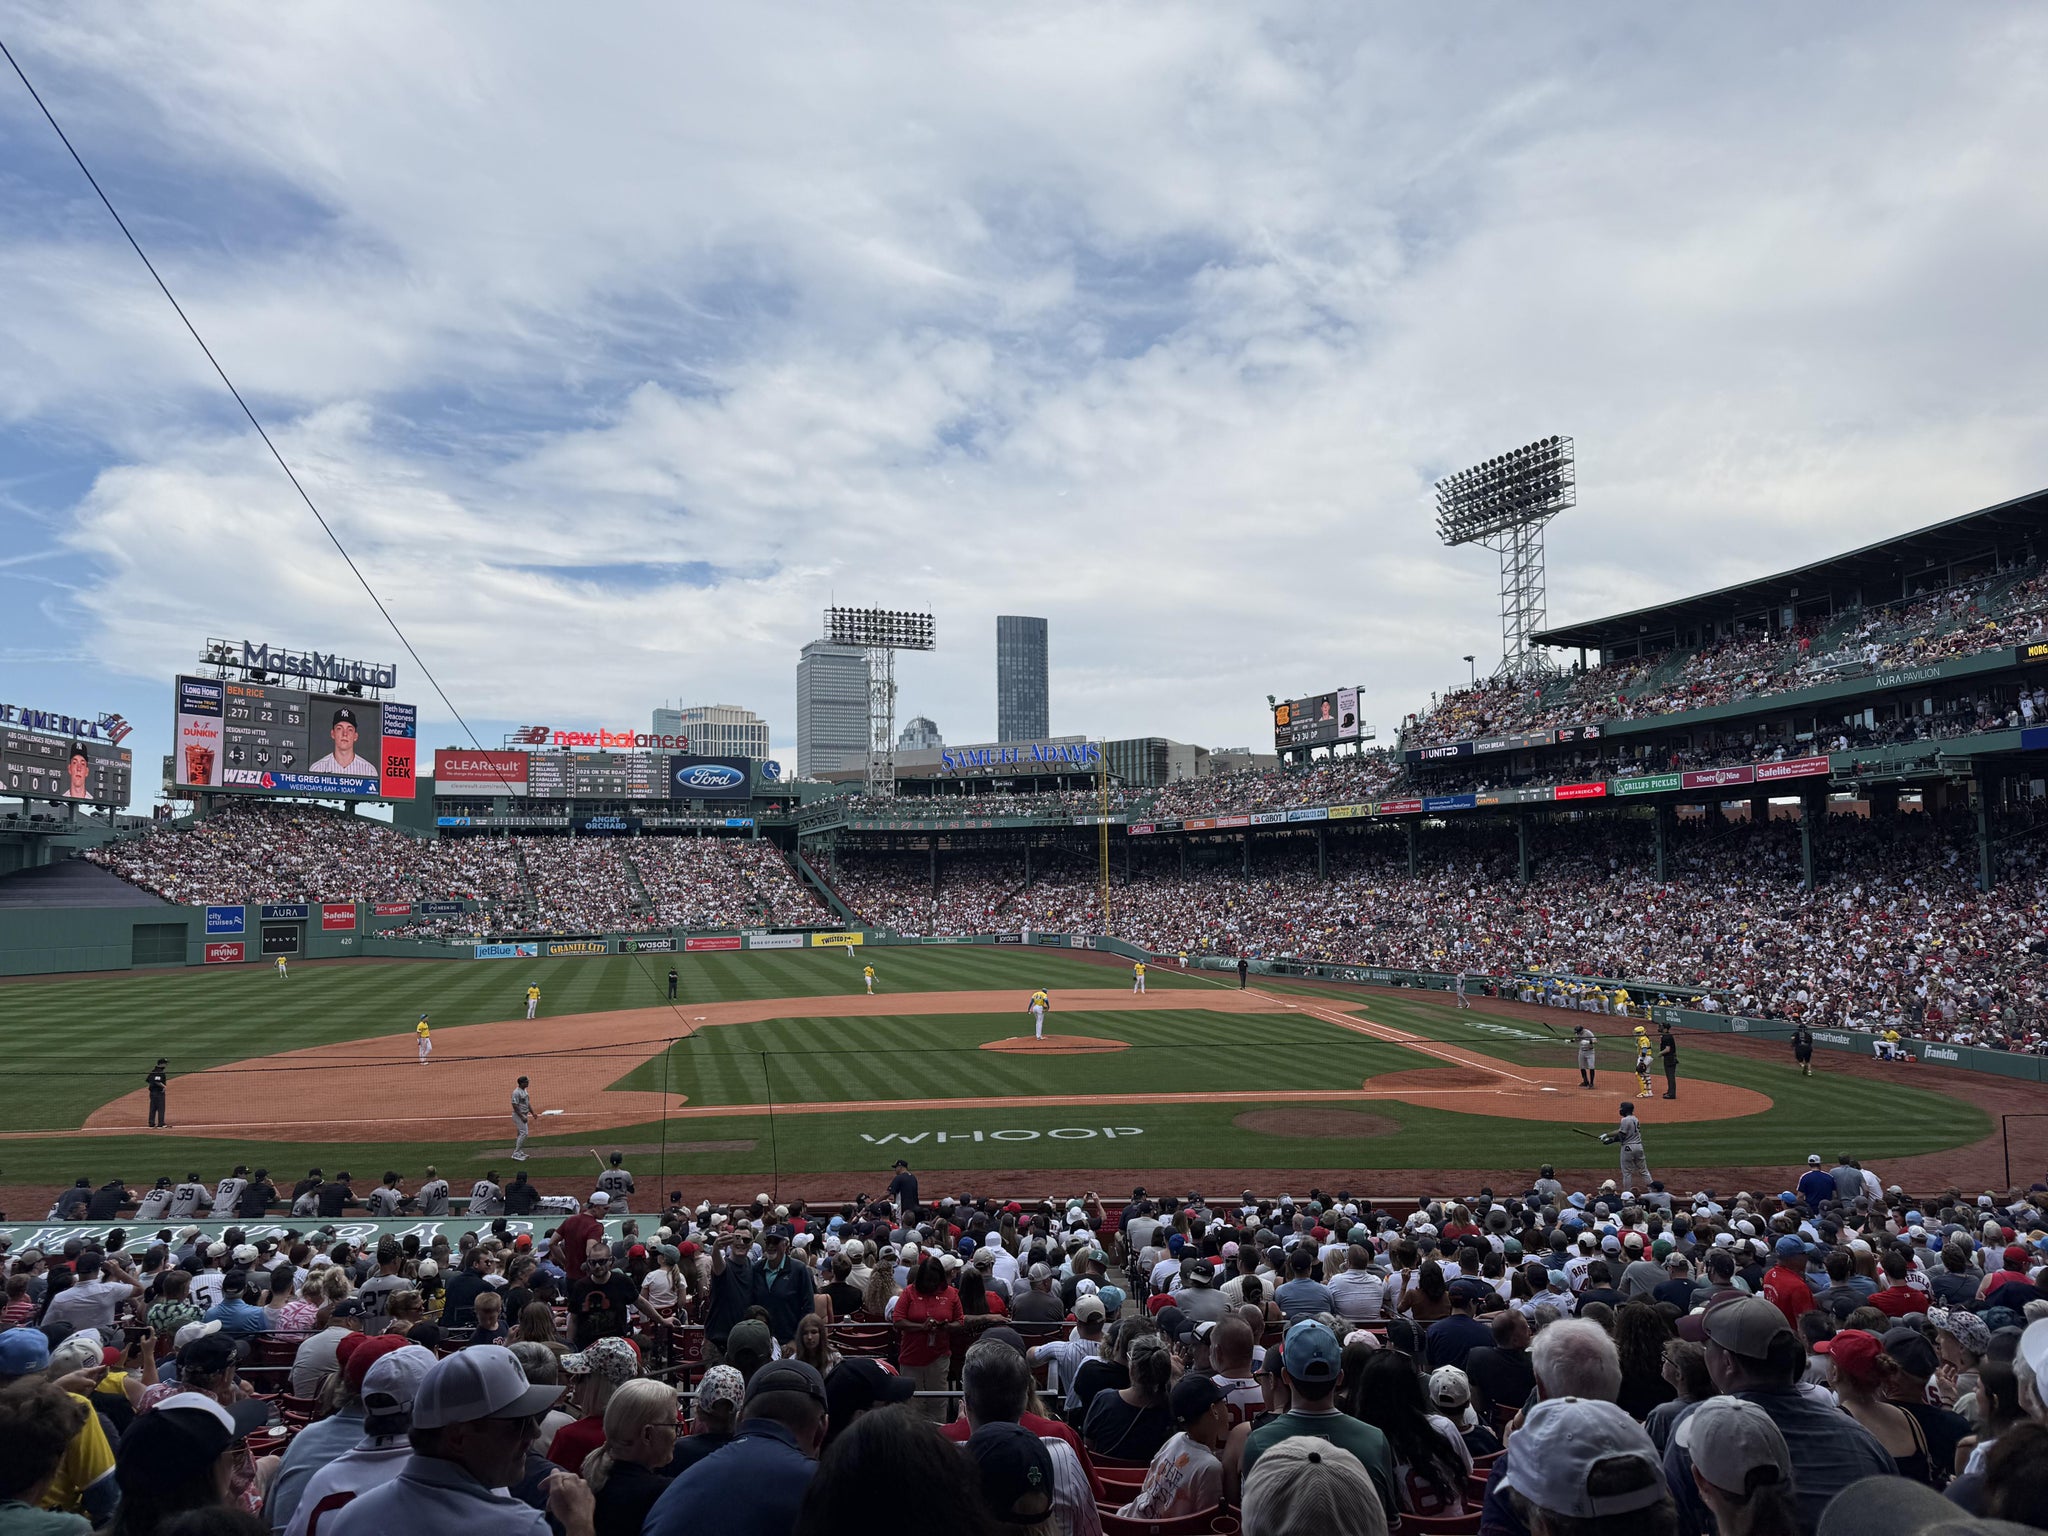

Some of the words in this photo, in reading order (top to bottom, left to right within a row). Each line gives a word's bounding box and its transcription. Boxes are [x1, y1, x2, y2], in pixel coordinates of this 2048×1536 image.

[244, 640, 397, 688] MassMutual
[1904, 667, 1940, 681] PAVILION
[185, 685, 200, 694] LONG
[202, 687, 218, 697] HOME
[228, 686, 244, 696] BEN
[246, 687, 264, 698] RICE
[384, 705, 397, 713] Beth
[398, 706, 414, 714] Israel
[228, 708, 249, 719] .277
[261, 712, 272, 721] 22
[288, 714, 300, 724] 53
[384, 713, 414, 722] Deaconess
[20, 707, 98, 738] AMERICA
[384, 720, 406, 728] Medical
[184, 728, 218, 738] DUNKIN'
[226, 727, 250, 735] DESIGNATED
[252, 728, 266, 736] HITTER
[384, 727, 404, 736] Center
[18, 733, 44, 743] CHALLENGES
[44, 737, 66, 747] REMAINING
[554, 731, 597, 746] new
[600, 728, 689, 749] balance
[8, 741, 18, 749] NYY
[41, 746, 50, 754] BOS
[1428, 746, 1458, 758] UNITED
[229, 752, 245, 760] 4-3
[258, 752, 269, 762] 3U
[282, 755, 293, 763] DP
[388, 756, 410, 768] SEAT
[942, 746, 1026, 772] SAMUEL
[1028, 743, 1101, 763] ADAMS
[8, 764, 24, 772] BALLS
[27, 766, 45, 775] STRIKES
[444, 760, 519, 772] CLEAResult
[1758, 766, 1792, 777] Safelite
[224, 768, 262, 784] WEEI
[280, 774, 296, 782] THE
[298, 775, 320, 784] GREG
[321, 777, 338, 785] HILL
[340, 778, 363, 787] SHOW
[386, 767, 411, 779] GEEK
[690, 768, 730, 785] Ford
[1696, 774, 1715, 783] Ninety
[1726, 772, 1740, 780] Nine
[13, 775, 18, 787] 0
[33, 777, 38, 790] 0
[52, 780, 57, 792] 0
[290, 784, 323, 792] WEEKDAYS
[1652, 778, 1678, 788] PICKLES
[272, 906, 298, 917] ĀURA
[390, 904, 410, 913] TICKET
[323, 912, 355, 920] Safelite
[550, 943, 586, 954] GRANITE
[588, 942, 606, 952] CITY
[638, 940, 671, 948] wasabi
[478, 946, 511, 956] jetBlue
[1812, 1031, 1850, 1046] smartwater
[1924, 1045, 1958, 1061] Franklin
[860, 1126, 1144, 1144] WHOOP
[218, 1182, 235, 1193] 78
[605, 1177, 622, 1190] 35
[177, 1188, 195, 1200] 39
[433, 1185, 448, 1199] 48
[474, 1185, 488, 1198] 13
[1572, 1264, 1587, 1277] RAF
[1904, 1276, 1930, 1290] EFIELD
